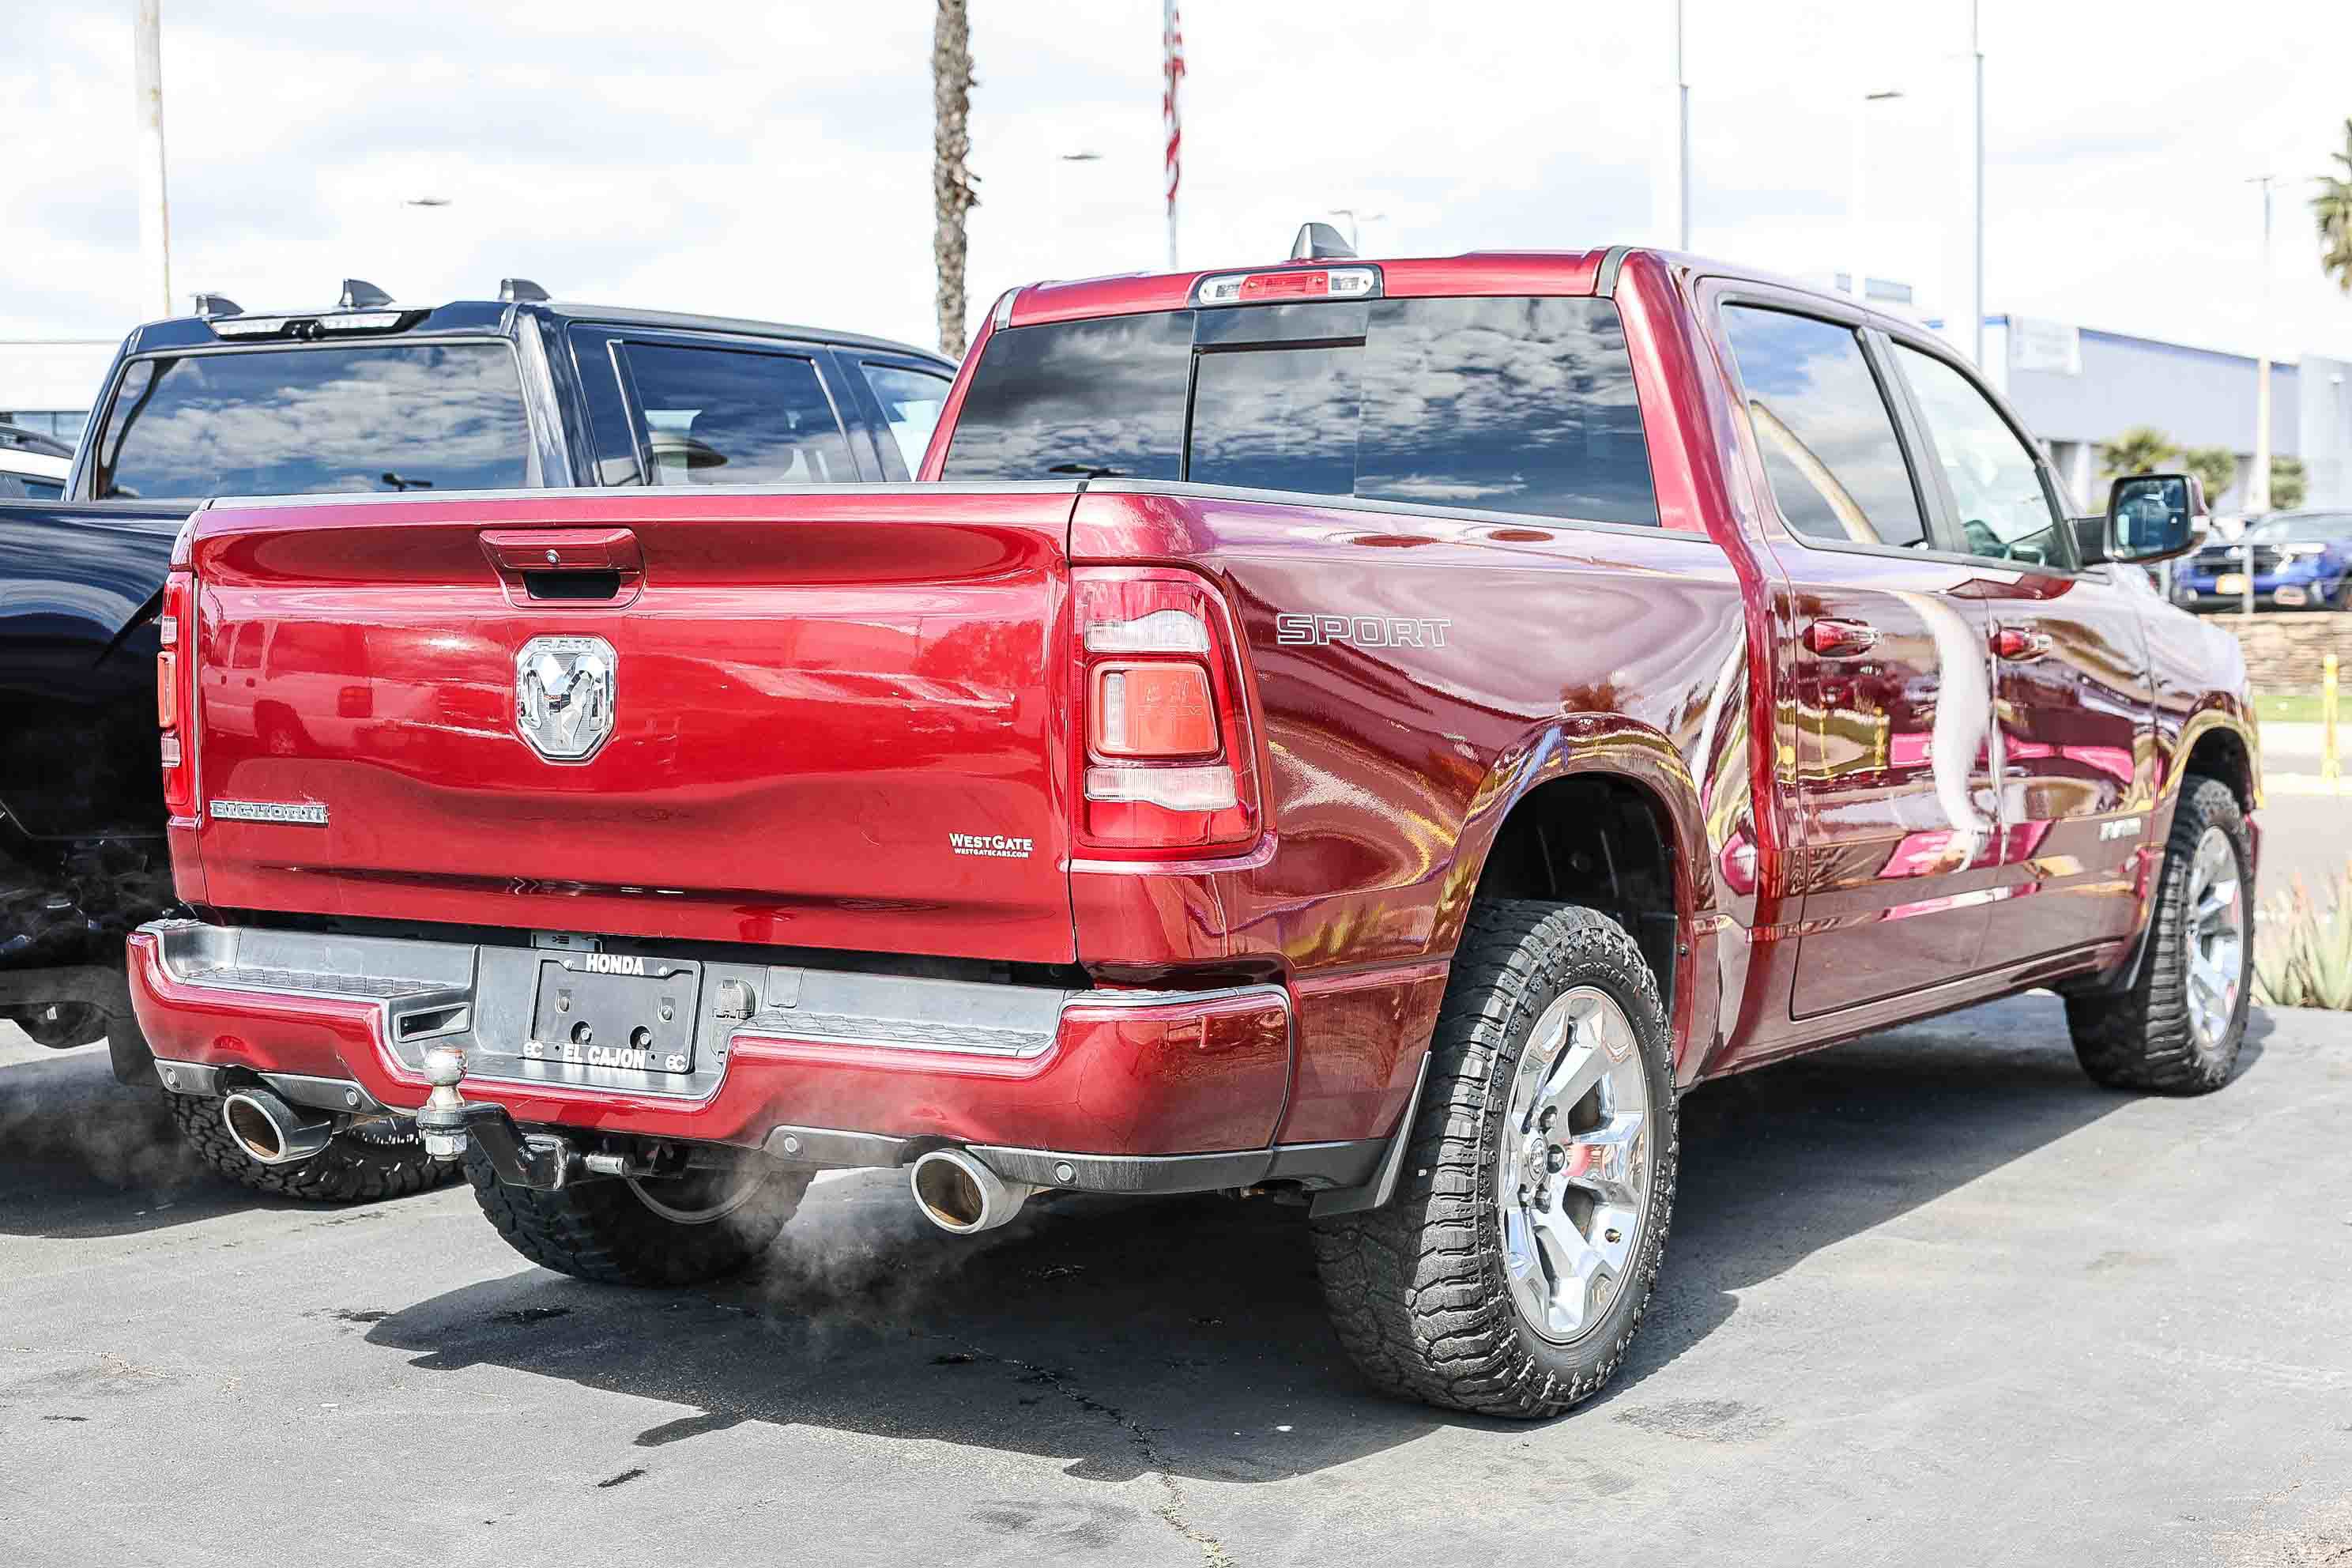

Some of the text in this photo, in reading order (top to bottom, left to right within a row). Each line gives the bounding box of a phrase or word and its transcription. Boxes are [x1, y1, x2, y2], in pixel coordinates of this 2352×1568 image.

[1276, 612, 1452, 647] SPORT
[536, 638, 594, 650] RAM
[586, 953, 645, 976] HONDA
[562, 1042, 646, 1069] EL CAJON
